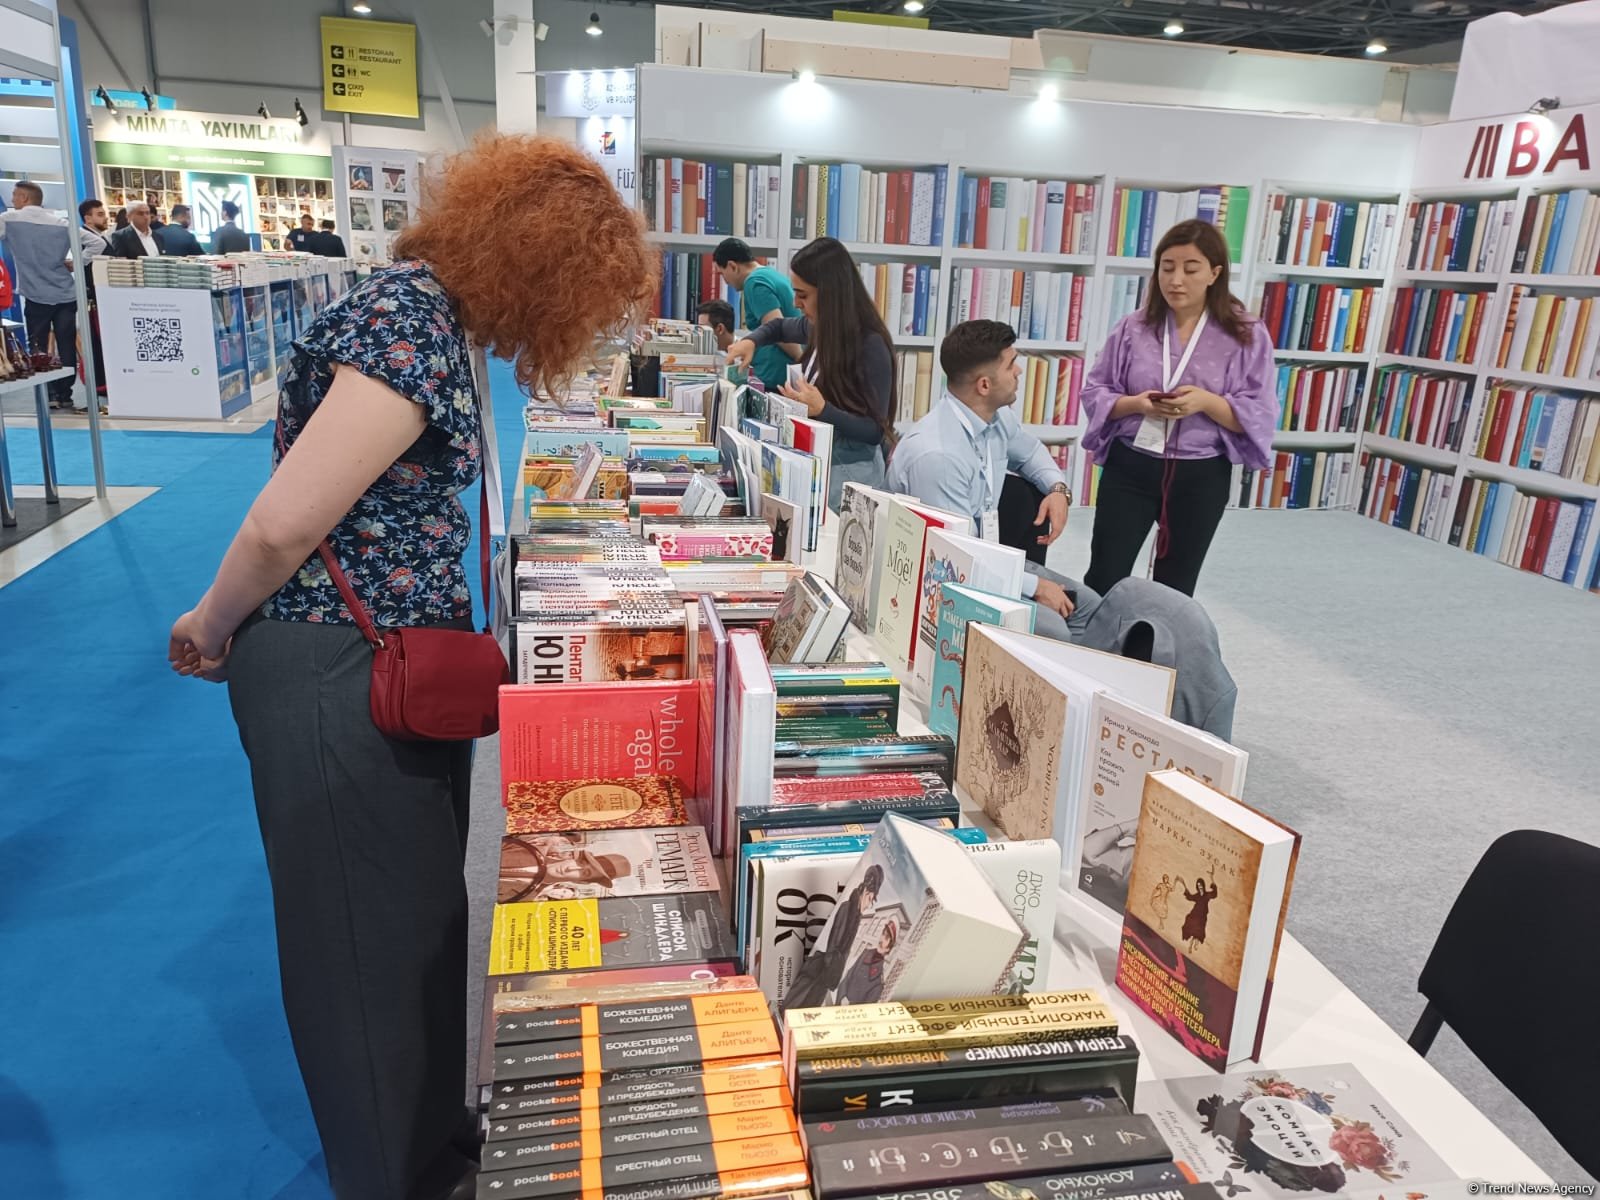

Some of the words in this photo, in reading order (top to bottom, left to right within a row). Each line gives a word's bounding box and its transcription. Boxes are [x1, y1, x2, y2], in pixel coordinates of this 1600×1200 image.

[358, 47, 394, 57] RESTORAN
[358, 55, 402, 64] RESTAURANT
[887, 545, 914, 585] Моё!
[658, 695, 684, 771] whole
[626, 727, 655, 777] agai
[681, 831, 703, 854] Эрих
[1151, 817, 1194, 849] МАРКУС
[1199, 847, 1237, 878] ЗУСАК
[654, 832, 690, 889] РЕМАРК
[689, 855, 710, 889] Мария
[1027, 870, 1043, 908] ДЖО
[559, 912, 569, 941] ПЕРВОГО
[570, 925, 585, 939] 40
[652, 903, 673, 962] ШИНДЛЕРА
[667, 910, 688, 952] СПИСОК
[571, 940, 580, 952] ЛЕТ
[1123, 939, 1169, 982] ЭКСКЛЮЗИВНОЕ
[1169, 977, 1200, 1007] ИЗДАНИЕ
[1127, 953, 1144, 974] ЧЕСТЬ
[1144, 968, 1204, 1024] ПЯТНАДЦАТИЛЕТИЯ
[603, 1004, 688, 1018] БОЖЕСТВЕННАЯ
[714, 999, 745, 1010] Данте
[877, 1000, 945, 1018] ЭФФЕКТ
[949, 992, 1091, 1013] НАКОПИТЕЛЬНЫЙ
[1121, 960, 1174, 1012] МЕЖДУНАРОДНОГО
[1174, 1007, 1221, 1049] БЕСТСЕЛЛЕРА
[619, 1012, 674, 1025] КОМЕДИЯ
[703, 1006, 760, 1018] АЛИГЬЕРИ
[959, 1009, 1106, 1032] НАКОПИТЕЛЬНЫЙ
[525, 1016, 581, 1029] pocketbook
[886, 1016, 954, 1036] ЭФФЕКТ
[605, 1034, 694, 1050] БОЖЕСТВЕННАЯ
[710, 1035, 768, 1049] АЛИГЬЕРИ
[721, 1029, 753, 1039] Данте
[622, 1044, 680, 1059] КОМЕДИЯ
[964, 1039, 1073, 1062] КИССИНДЖЕР
[1075, 1035, 1128, 1057] ГЕНРИ
[524, 1051, 582, 1064] pocketbook
[809, 1056, 862, 1075] СИЛОЙ
[865, 1049, 949, 1068] УПРАВЛЯТЬ
[523, 1077, 583, 1091] pocketbook
[616, 1085, 696, 1101] ПРЕДУБЕЖДЕНИЕ
[627, 1080, 675, 1092] ГОРДОСТЬ
[518, 1094, 580, 1108] pocketbook
[629, 1101, 678, 1113] ГОРДОСТЬ
[517, 1115, 581, 1131] pocketbook
[616, 1106, 700, 1122] ПРЕДУБЕЖДЕНИЕ
[737, 1114, 768, 1123] Марио
[614, 1127, 670, 1143] КРЕСТНЫЙ
[671, 1125, 699, 1138] ОТЕЦ
[1256, 1105, 1305, 1160] ЭМОЦИЙ
[1273, 1103, 1322, 1158] КОМПАС
[516, 1139, 581, 1156] pocketbook
[742, 1142, 774, 1151] Марио
[615, 1157, 672, 1173] КРЕСТНЫЙ
[673, 1154, 703, 1167] ОТЕЦ
[513, 1169, 581, 1187] pocketbook
[1045, 1170, 1136, 1191] ДОНОХЬЮ
[605, 1188, 665, 1200] Фридрих
[666, 1179, 720, 1198] НИЦШЕ
